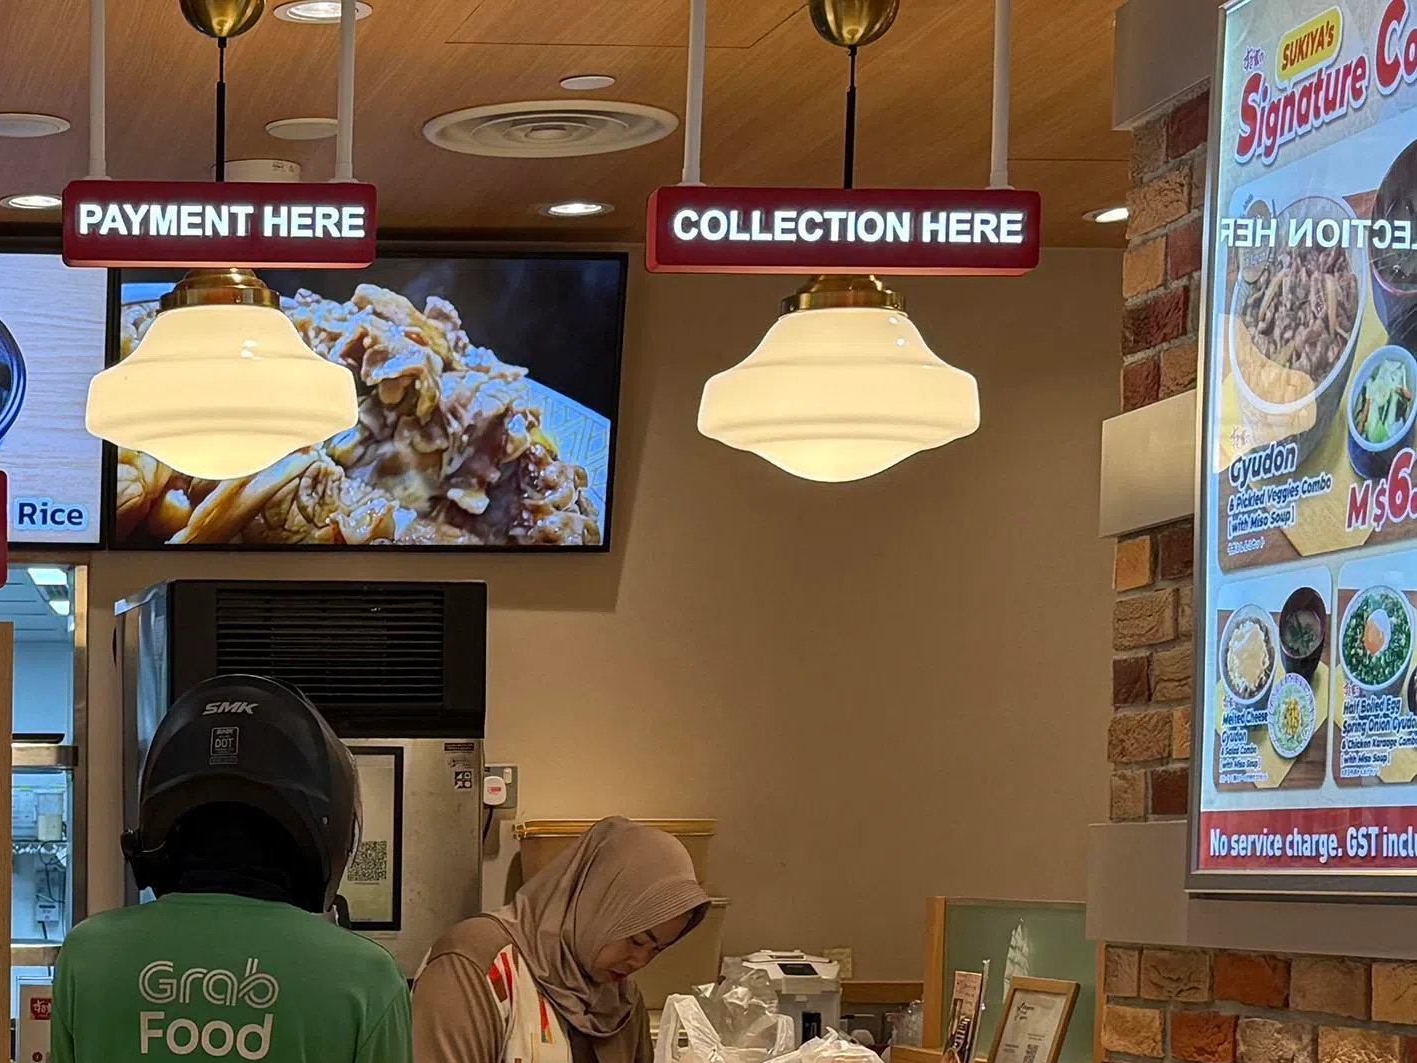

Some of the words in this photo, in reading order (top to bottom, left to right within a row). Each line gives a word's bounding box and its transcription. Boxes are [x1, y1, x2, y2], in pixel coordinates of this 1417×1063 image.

[1282, 20, 1335, 70] SUKIYA's
[1236, 55, 1367, 158] Signature
[79, 203, 254, 237] PAYMENT
[263, 206, 366, 238] HERE
[673, 209, 911, 243] COLLECTION
[922, 211, 1024, 244] HERE
[1230, 442, 1296, 488] Gyudon
[1236, 489, 1265, 510] Pickled
[1267, 484, 1300, 505] Veggies
[1302, 473, 1332, 495] Combo
[17, 501, 84, 527] Rice
[1251, 512, 1269, 529] Miso
[202, 701, 260, 716] SMK
[1246, 709, 1269, 723] Cheese
[1210, 829, 1227, 857] No
[1231, 828, 1282, 857] service
[1286, 828, 1342, 864] charge.
[1347, 826, 1379, 857] GST
[138, 958, 279, 1008] Grab
[140, 1011, 274, 1060] Food
